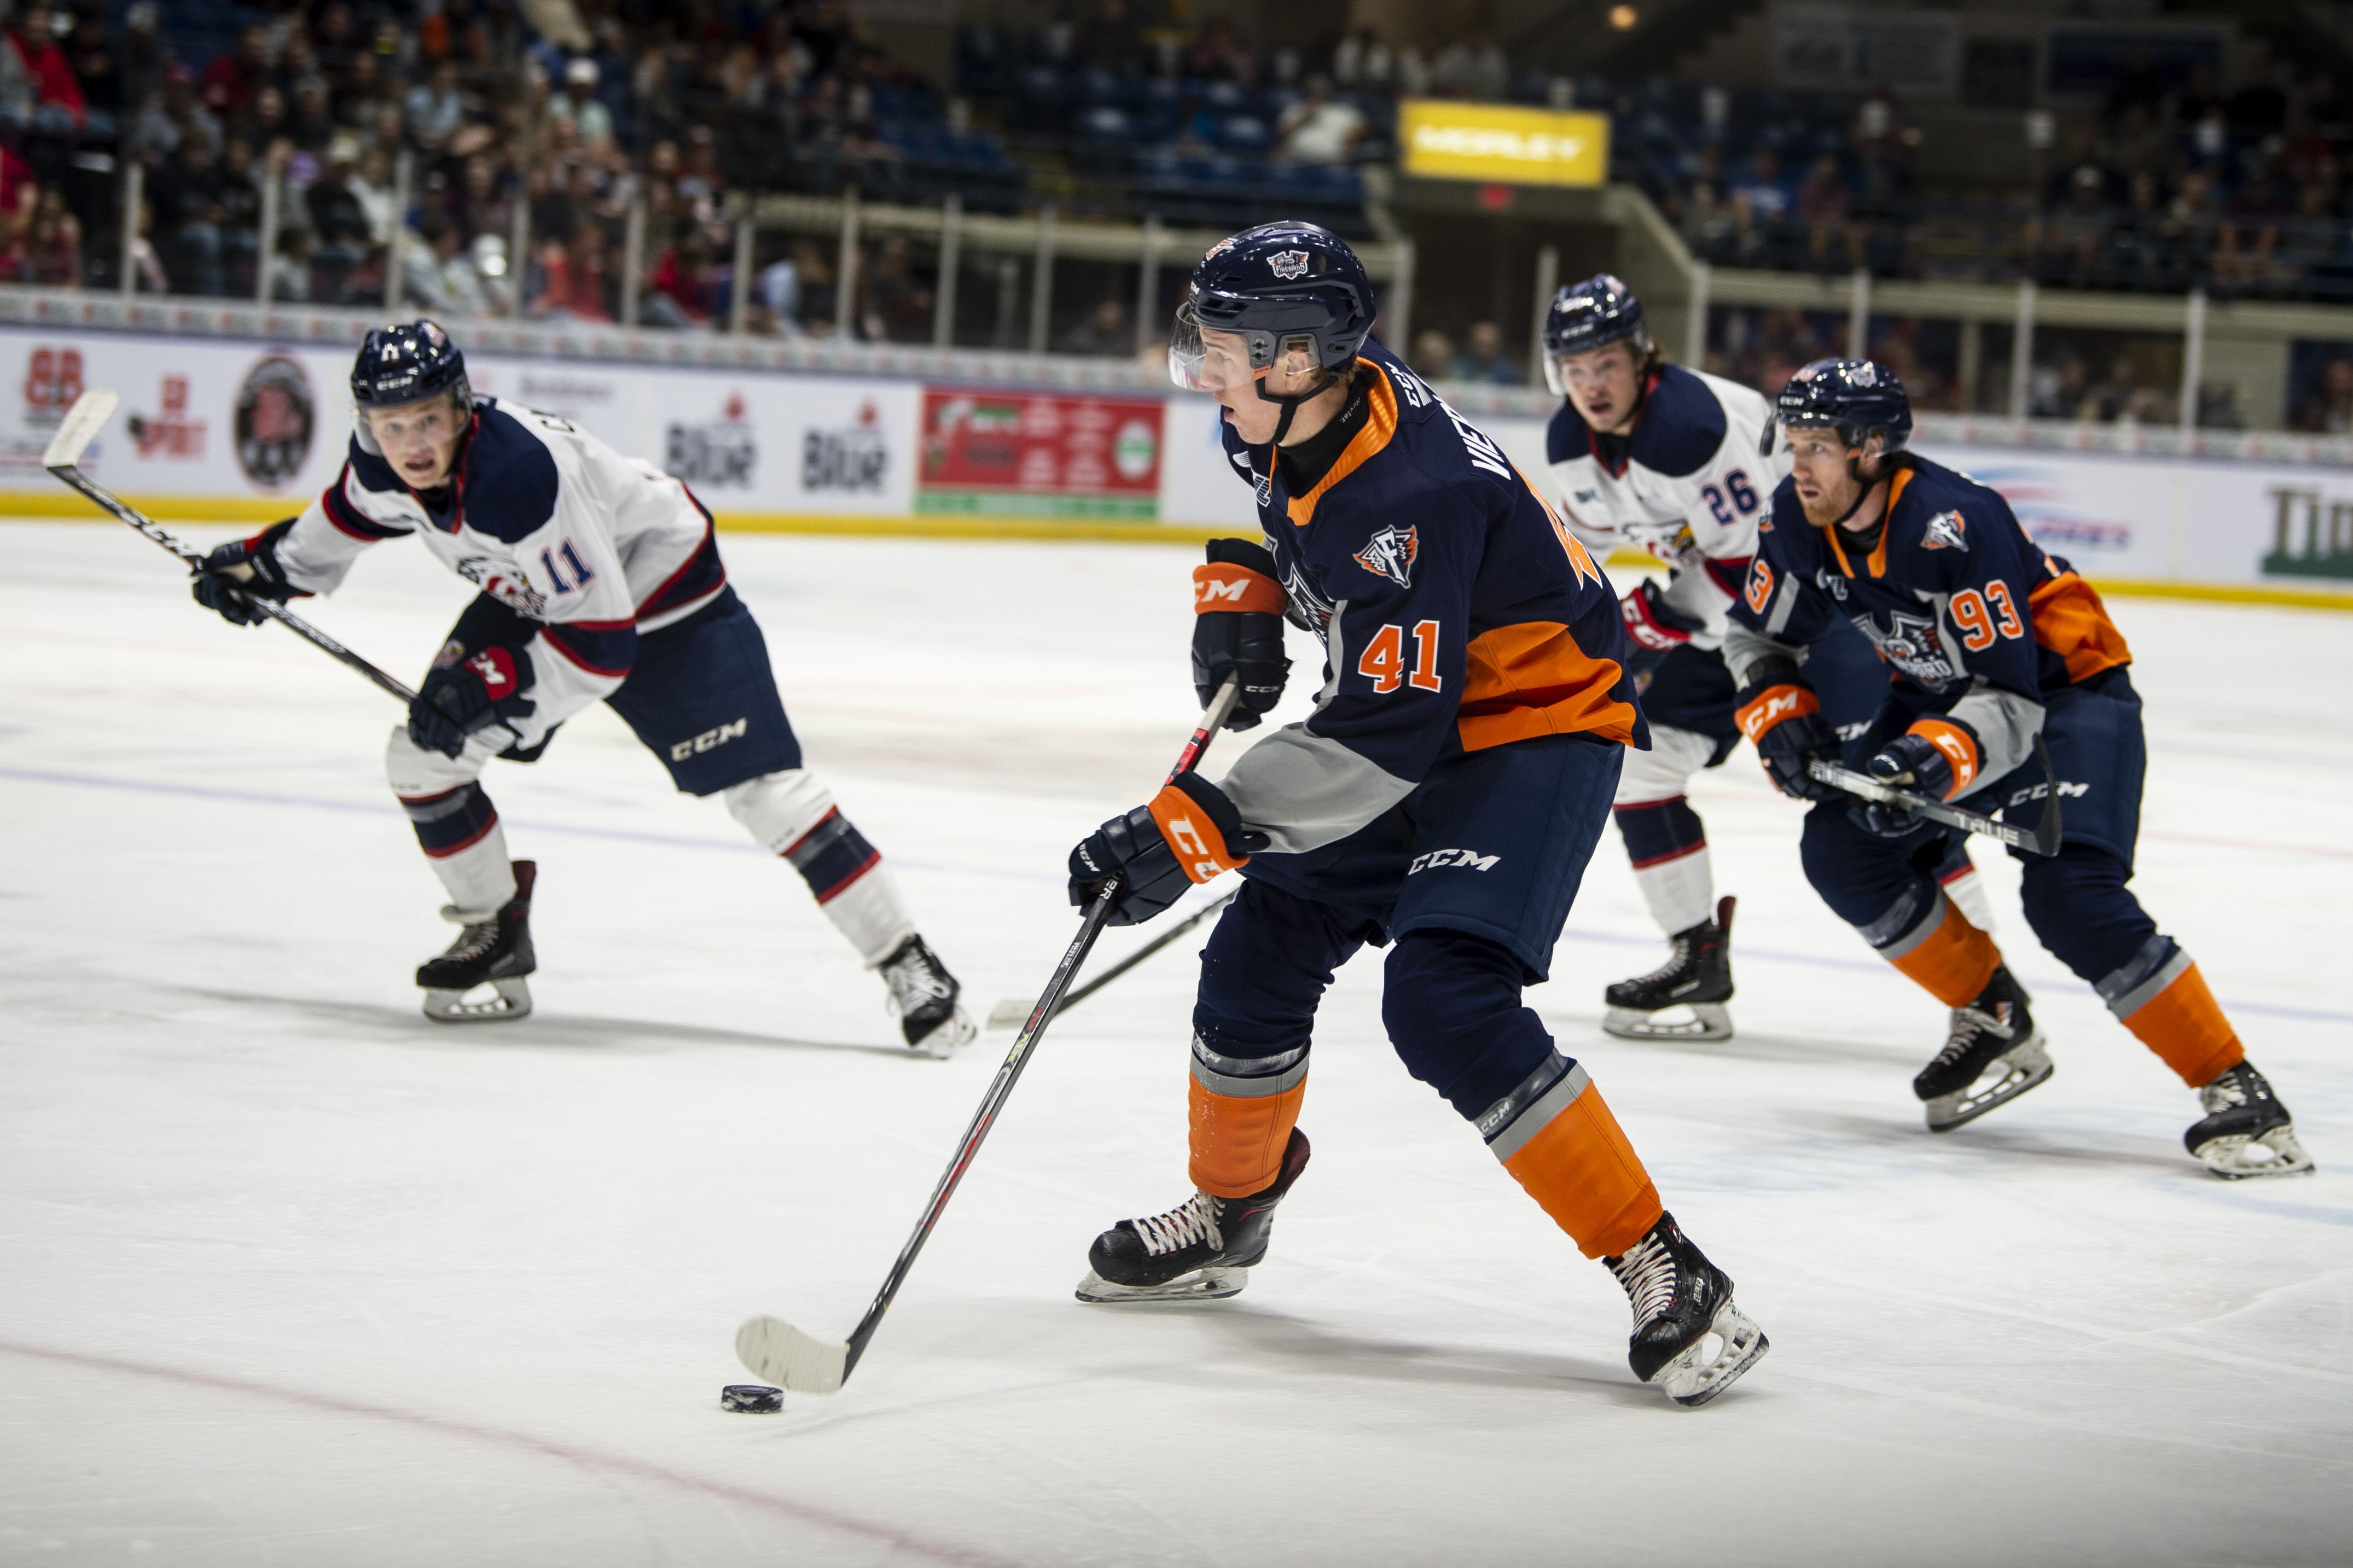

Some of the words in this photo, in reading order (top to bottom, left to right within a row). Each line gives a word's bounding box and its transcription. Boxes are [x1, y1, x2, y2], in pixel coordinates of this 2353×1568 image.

[1701, 468, 1761, 527] 26
[539, 535, 595, 597] 11
[1948, 578, 2024, 652] 93
[1358, 619, 1442, 694] 41
[670, 716, 748, 762] CCM
[2008, 780, 2090, 808] CCM
[1954, 811, 2019, 847] TRUE
[1408, 849, 1502, 876] CCM
[1480, 1100, 1510, 1134] CCM
